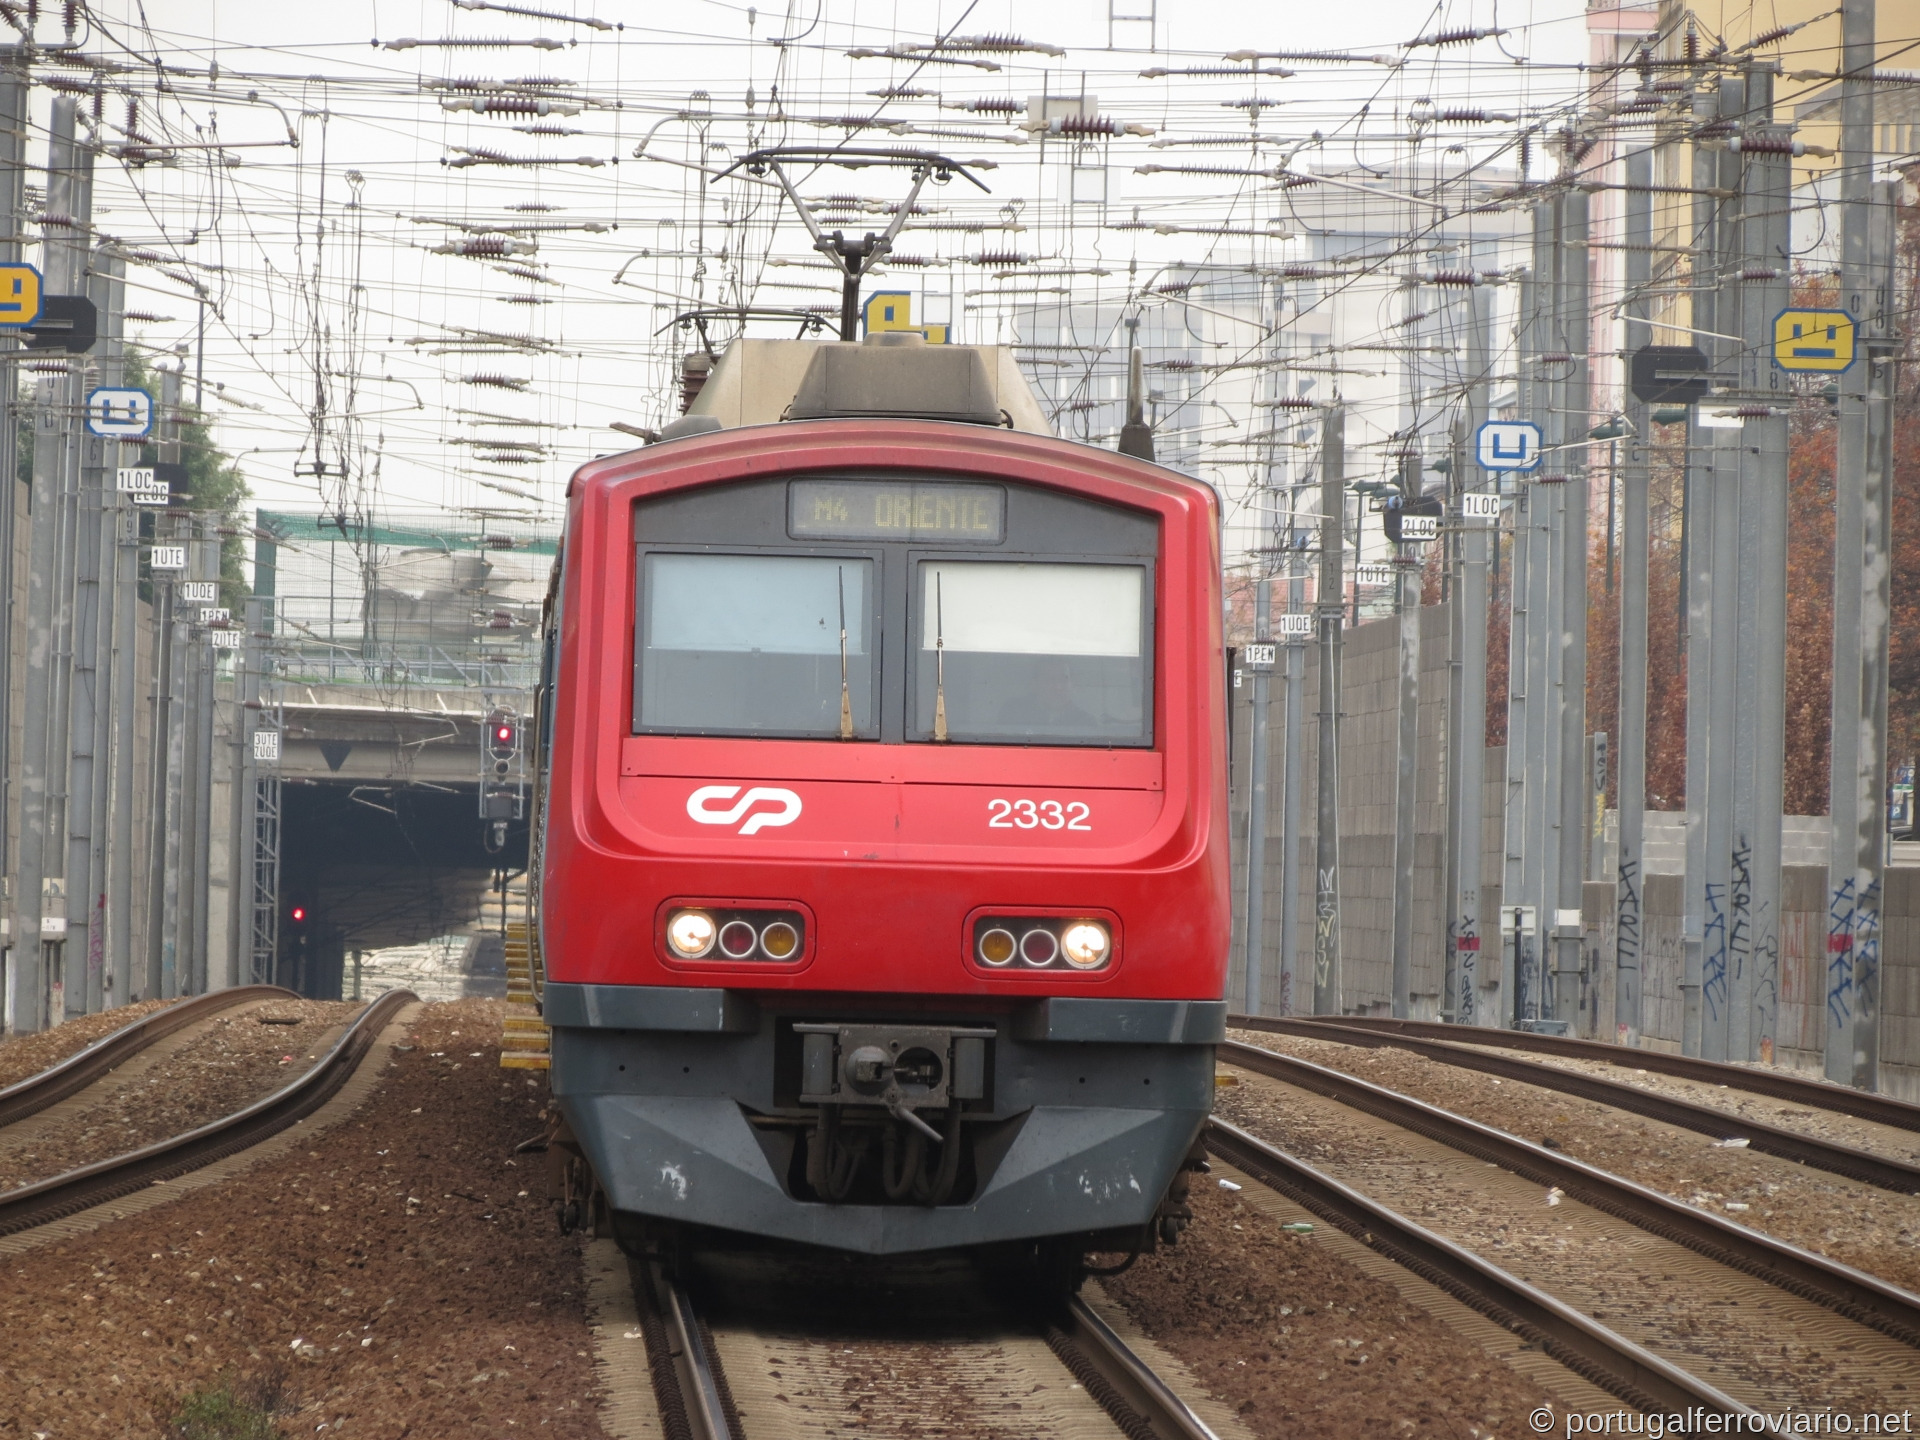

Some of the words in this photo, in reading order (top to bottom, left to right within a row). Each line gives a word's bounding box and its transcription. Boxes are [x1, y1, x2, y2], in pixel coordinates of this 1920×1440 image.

[119, 471, 151, 489] 1LOC
[814, 497, 849, 521] M4
[875, 494, 988, 530] ORIENTE
[1465, 497, 1499, 515] 1LOC
[1403, 519, 1436, 537] 2LOC
[152, 549, 183, 565] 1UTE
[1359, 566, 1389, 585] 1UTE
[1247, 646, 1275, 662] 1PEN
[255, 733, 277, 746] 3UTE
[687, 785, 802, 835] CP
[987, 799, 1092, 831] 2332
